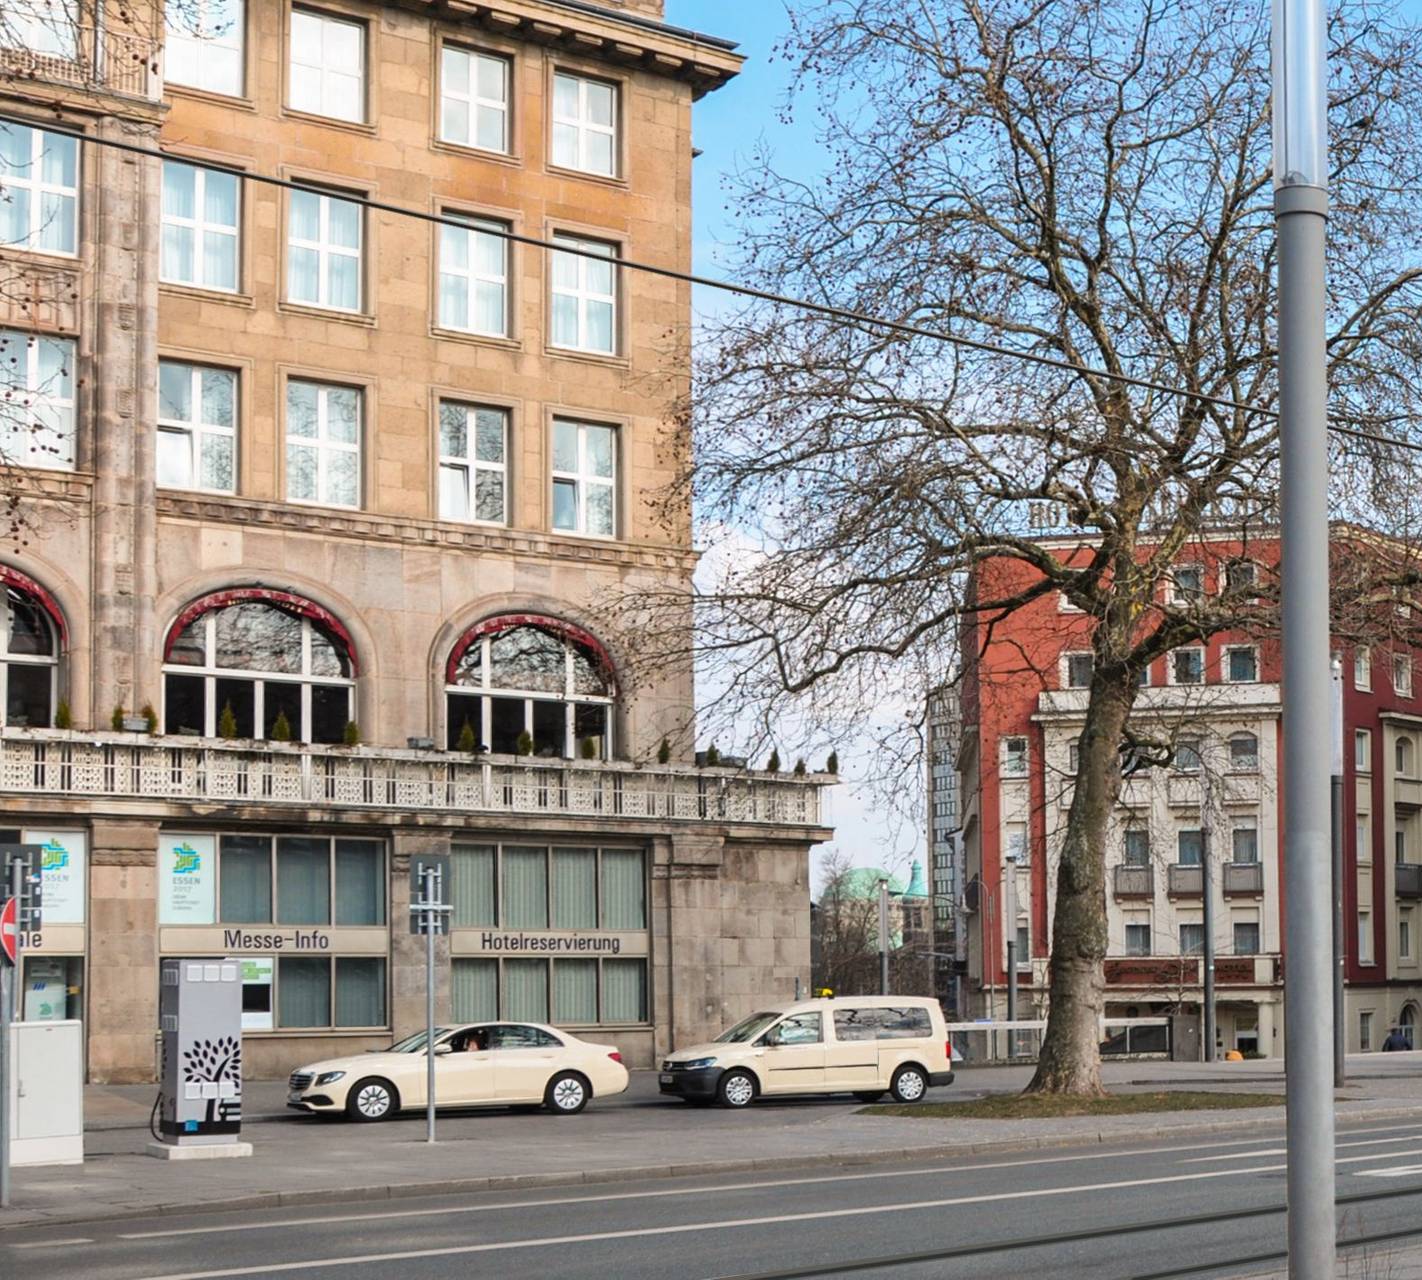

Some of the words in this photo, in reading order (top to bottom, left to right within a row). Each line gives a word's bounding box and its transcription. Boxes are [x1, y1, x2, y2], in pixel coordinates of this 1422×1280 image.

[172, 877, 200, 885] ESSEN
[224, 929, 329, 949] Messe-Info
[481, 932, 620, 954] Hotelreservierung
